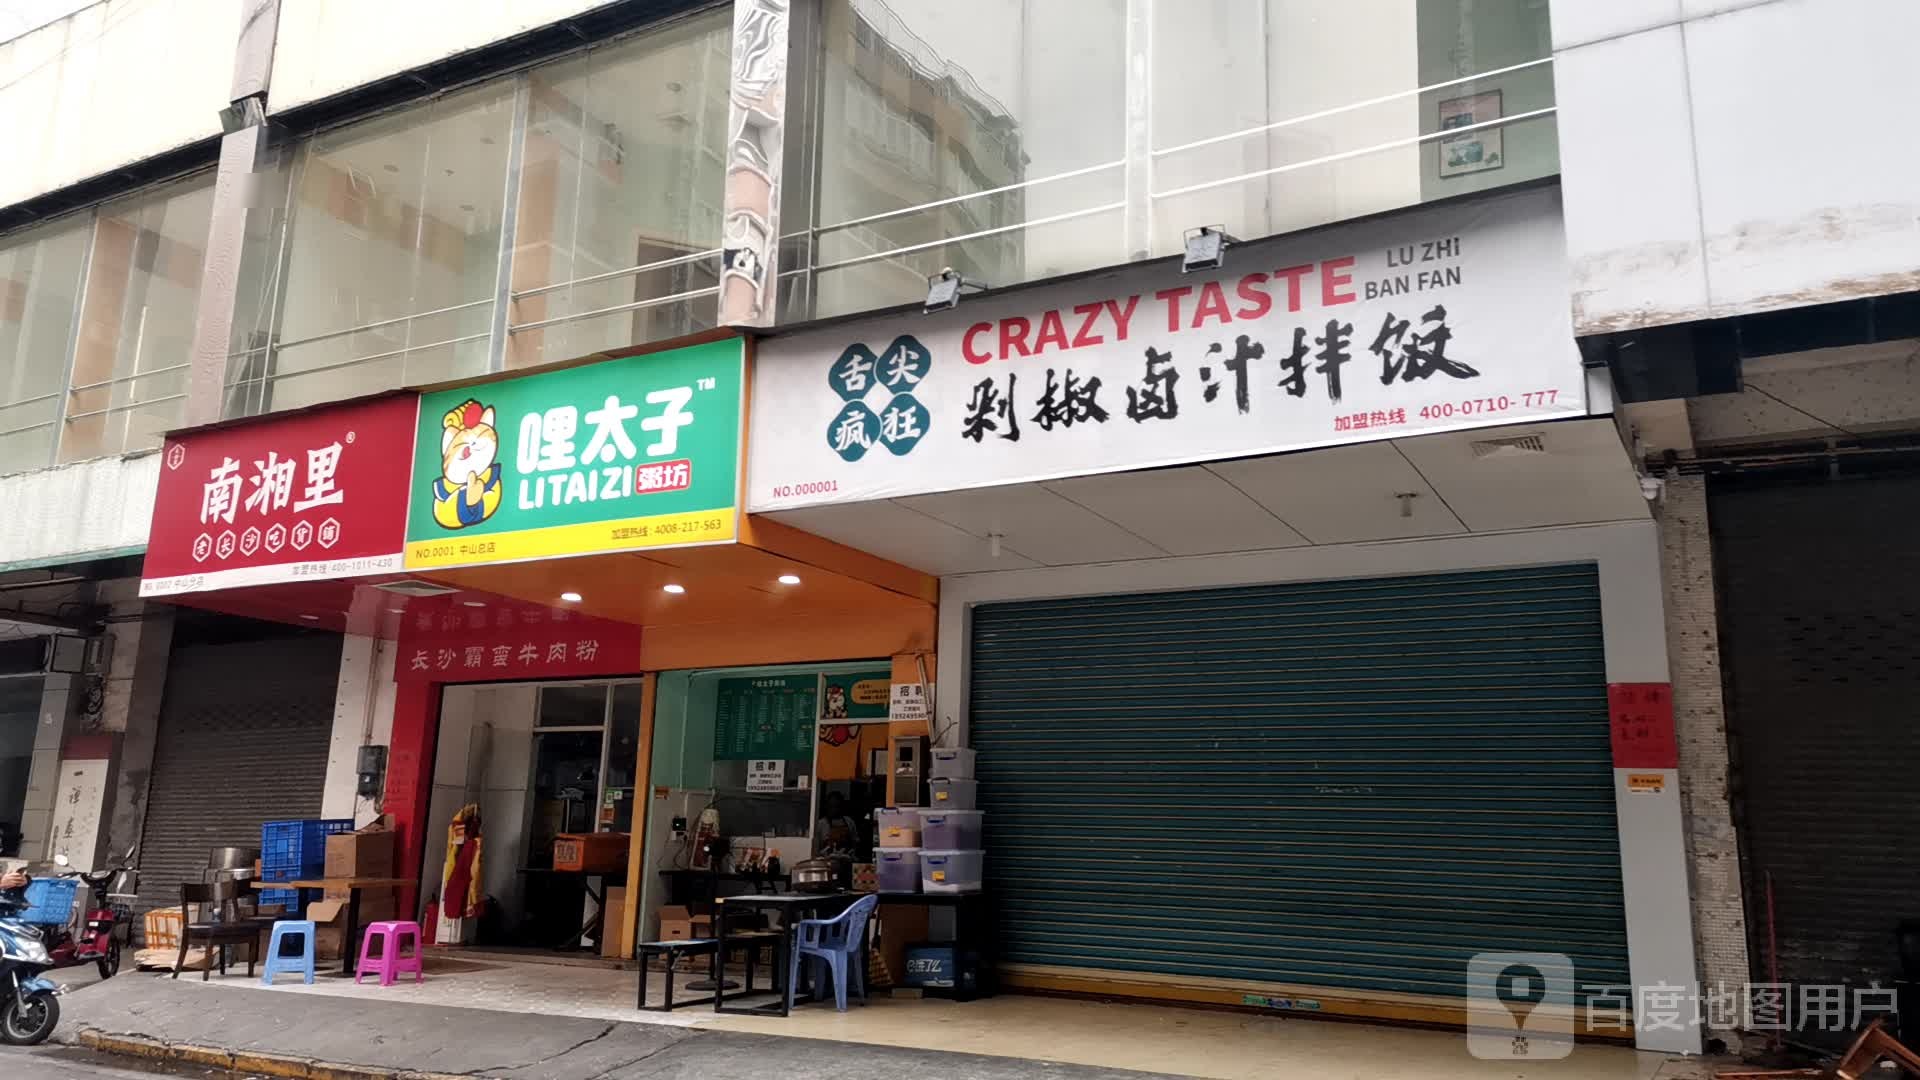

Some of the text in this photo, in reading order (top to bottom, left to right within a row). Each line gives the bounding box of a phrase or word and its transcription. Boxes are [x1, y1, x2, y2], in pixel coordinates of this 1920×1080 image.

[1386, 245, 1414, 268] LU
[1365, 265, 1462, 300] BAN FAN
[961, 255, 1358, 366] CRAZY TASTE
[838, 344, 922, 391] 舌尖
[516, 386, 695, 474] 哩太子
[833, 409, 922, 454] 疯狂
[1333, 407, 1407, 432] 加盟热线
[200, 441, 344, 525] 南湘里
[638, 463, 689, 490] 粥坊
[773, 479, 838, 497] NO.000001
